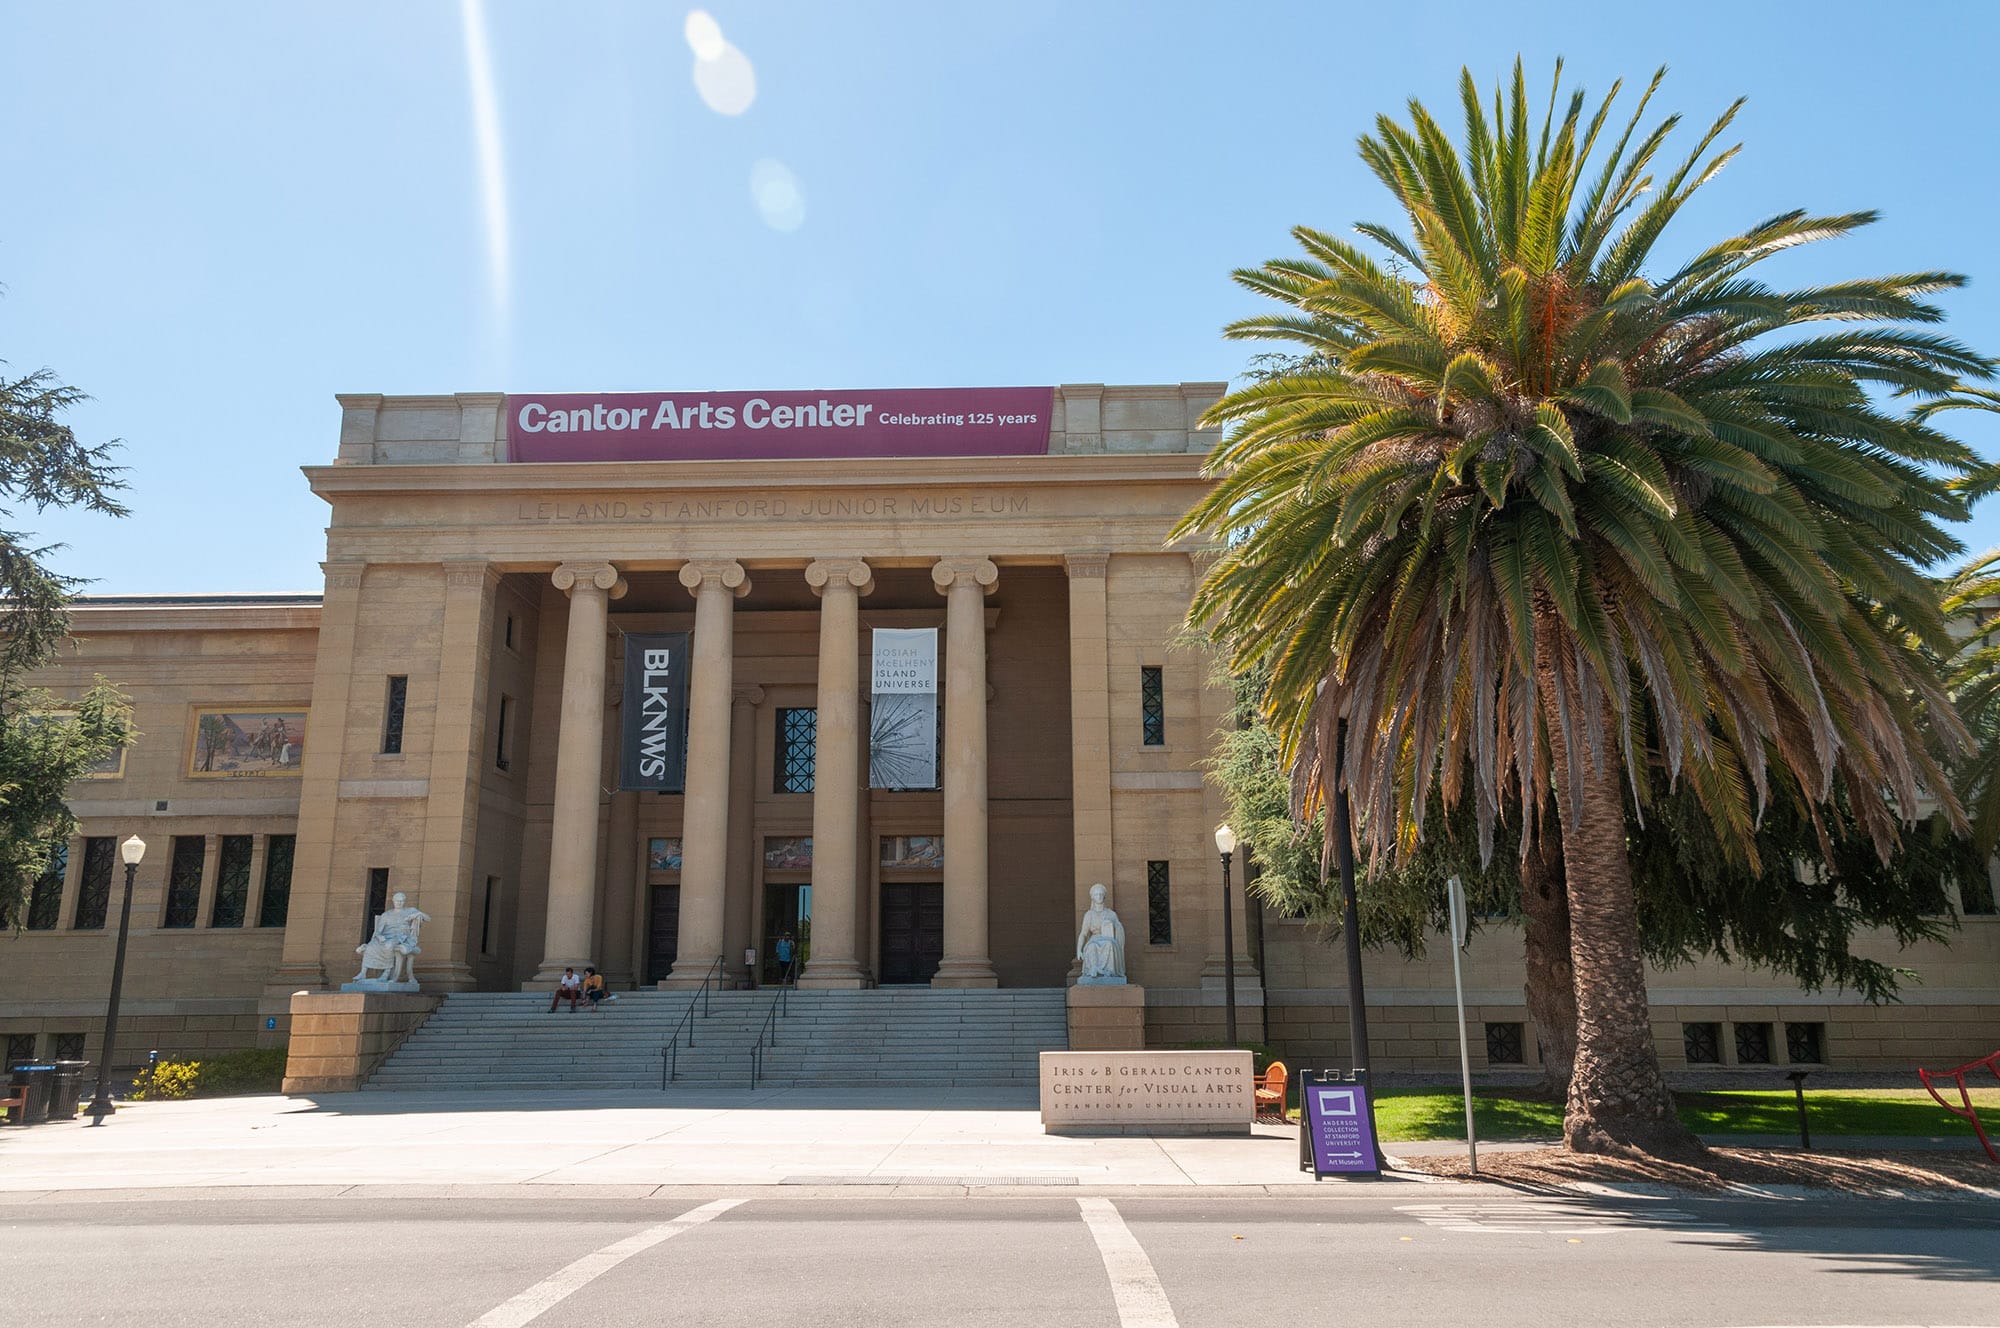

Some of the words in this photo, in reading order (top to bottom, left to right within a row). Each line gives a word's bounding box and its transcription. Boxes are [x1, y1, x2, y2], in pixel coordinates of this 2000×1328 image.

[518, 402, 648, 433] Cantor
[651, 400, 737, 430] Arts
[742, 398, 873, 430] Center
[878, 412, 964, 426] Celebrating
[968, 412, 994, 425] 125
[998, 412, 1037, 426] years
[518, 502, 628, 520] LELAND
[640, 500, 787, 519] STANFORD
[801, 498, 897, 516] JUNIOR
[911, 496, 1029, 514] MUSEUM
[876, 648, 918, 657] JOSIAH
[876, 669, 917, 678] ISLAND
[875, 680, 931, 689] UNIVERSE
[640, 649, 669, 777] BLKNWS
[1054, 1066, 1084, 1077] IRIS
[1105, 1066, 1112, 1077] B
[1119, 1066, 1176, 1077] GERALD
[1183, 1065, 1242, 1076] CANTOR
[1053, 1083, 1113, 1095] CENTER
[1118, 1084, 1138, 1097] for
[1144, 1082, 1198, 1094] VISUAL
[1205, 1082, 1243, 1094] ARTS
